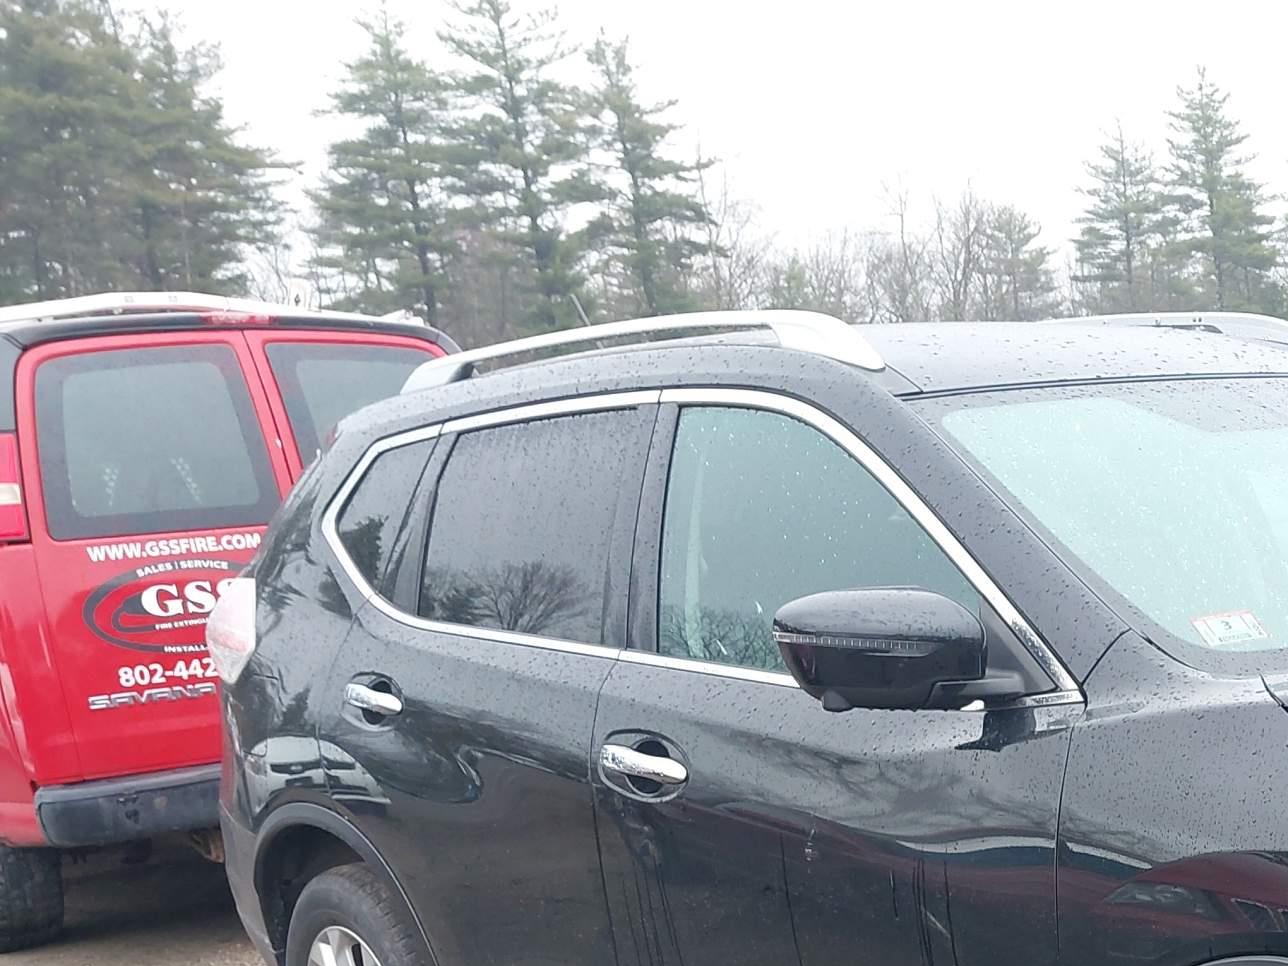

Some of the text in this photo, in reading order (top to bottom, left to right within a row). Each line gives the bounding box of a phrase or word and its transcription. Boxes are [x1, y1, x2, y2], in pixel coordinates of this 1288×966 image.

[86, 532, 261, 562] WWW.GSSFIRE.COM
[136, 563, 173, 578] SALES
[180, 559, 229, 570] SERVICE
[118, 657, 219, 688] 802-442
[87, 682, 217, 710] SAVANA
